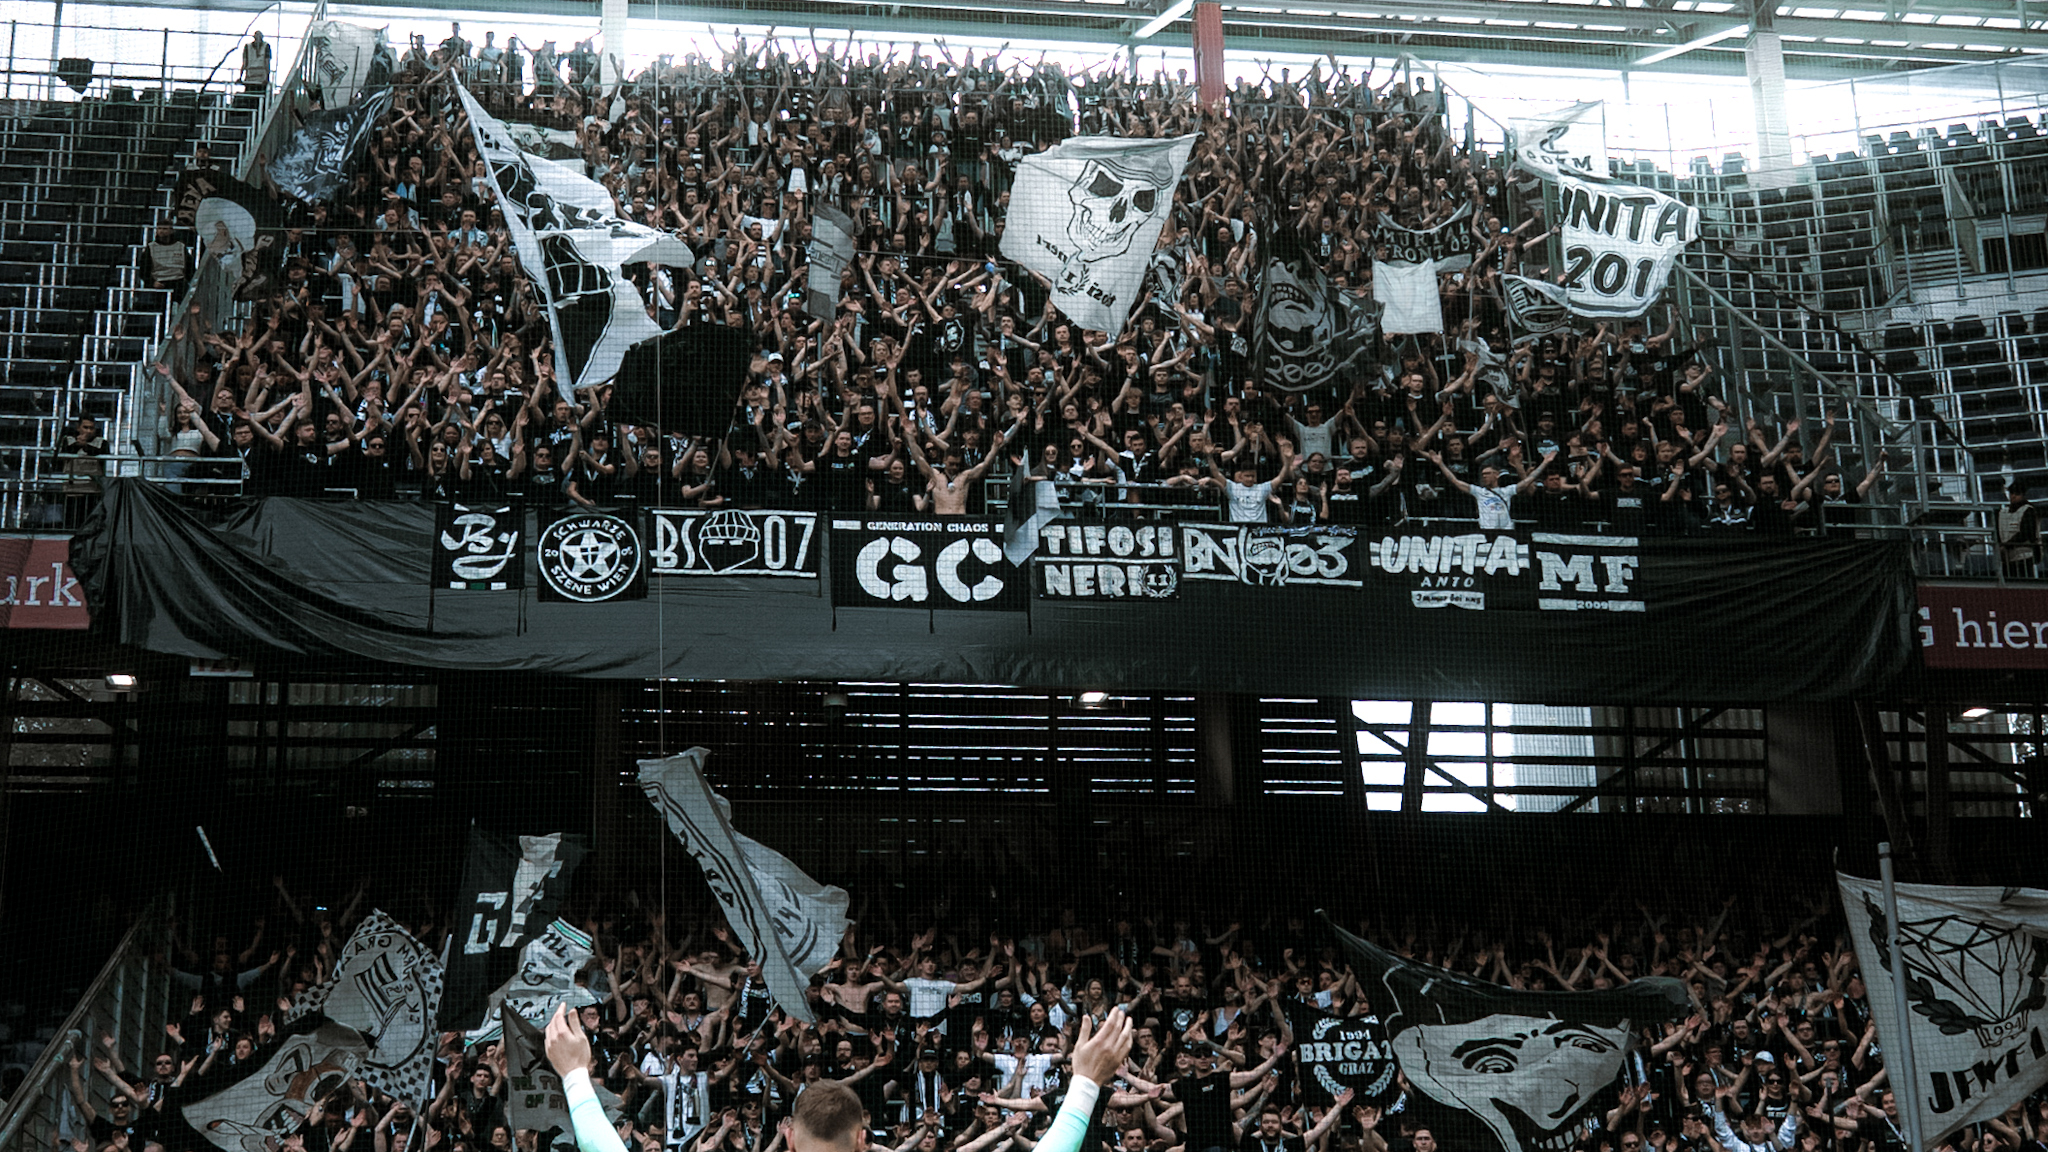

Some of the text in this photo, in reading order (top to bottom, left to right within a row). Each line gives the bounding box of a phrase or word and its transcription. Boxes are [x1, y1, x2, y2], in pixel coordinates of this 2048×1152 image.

[552, 519, 627, 541] SCHWARZE
[764, 515, 816, 570] 07
[867, 521, 989, 533] GENERATION CHAOS
[1040, 525, 1174, 557] TIFOSI
[856, 536, 1004, 602] GC
[1380, 533, 1520, 576] UNITA
[550, 564, 630, 595] SZENE WIEN
[1044, 564, 1143, 596] NERI
[1536, 551, 1639, 593] MF
[1577, 600, 1609, 610] 2009
[1982, 1016, 2022, 1041] 1994
[1338, 1062, 1375, 1076] GRAZ
